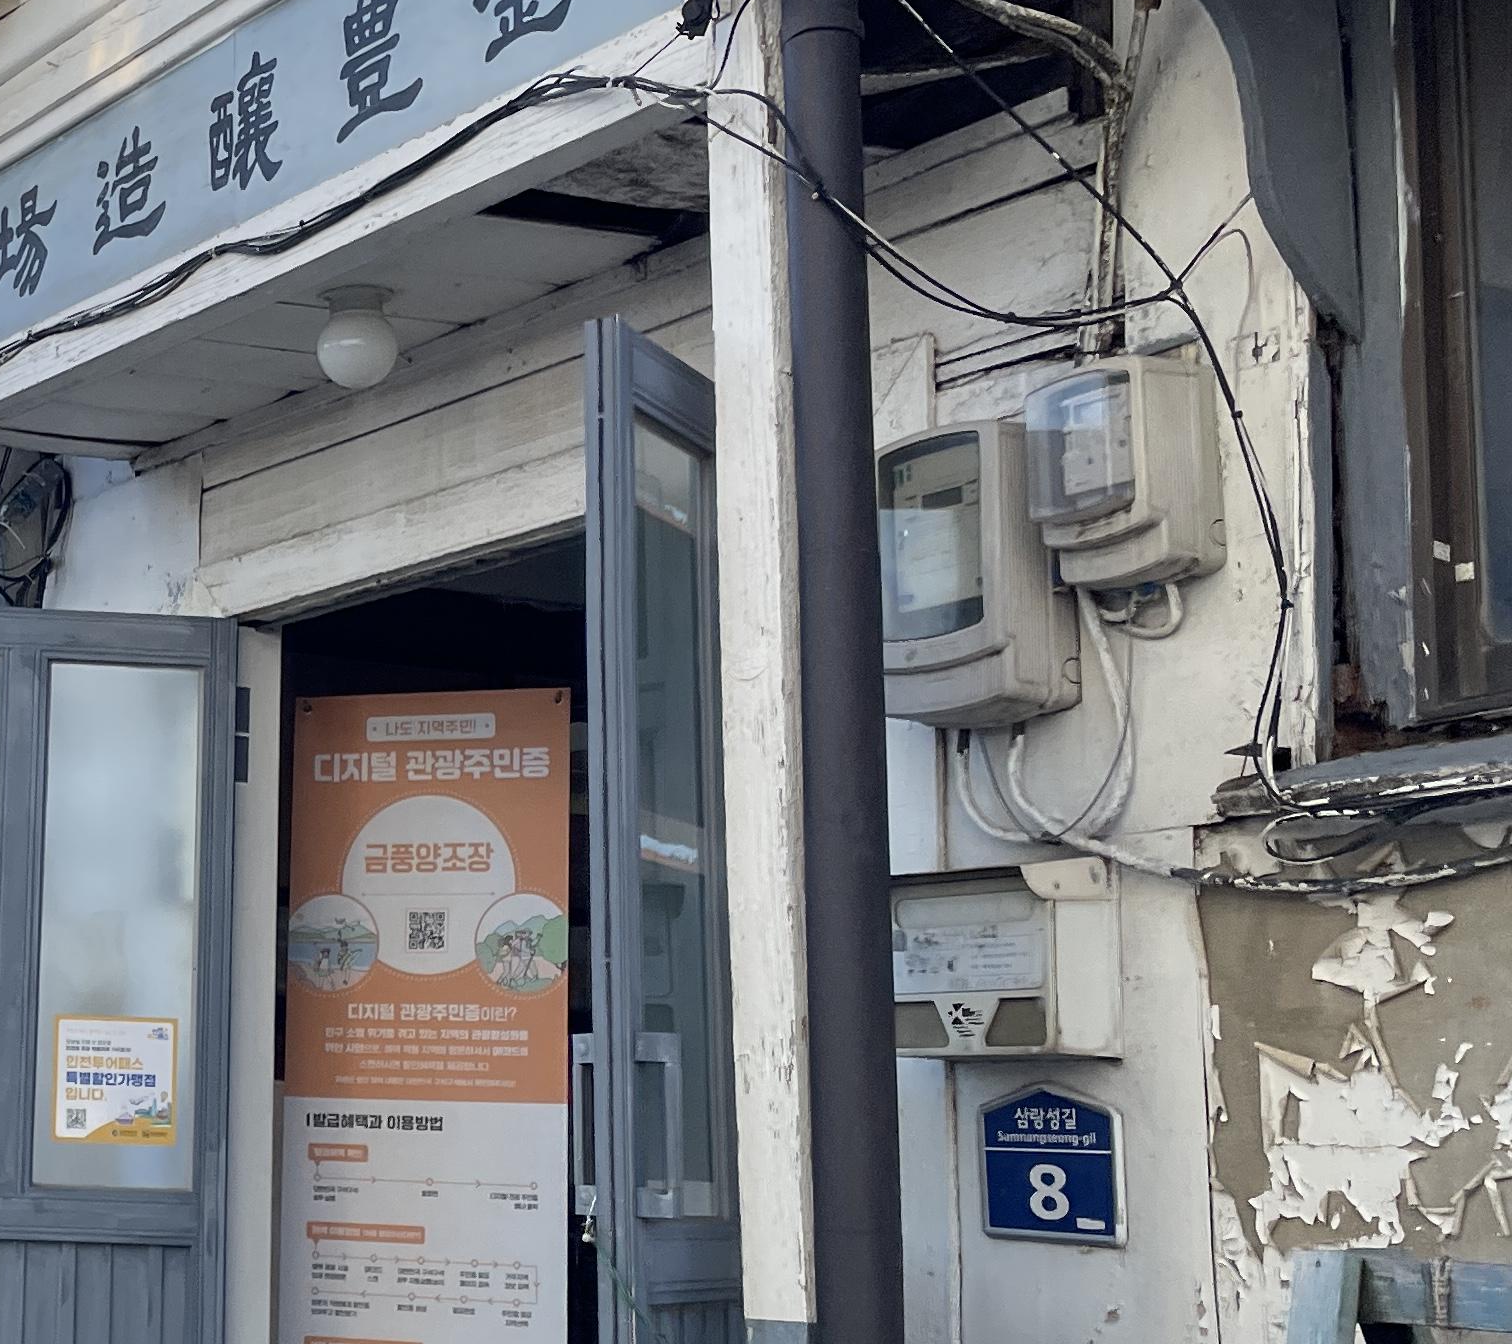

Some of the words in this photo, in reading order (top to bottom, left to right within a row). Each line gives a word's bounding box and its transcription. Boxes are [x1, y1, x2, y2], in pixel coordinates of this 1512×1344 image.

[313, 751, 397, 783] 디지털
[405, 746, 551, 782] 관광주민증
[364, 842, 494, 874] 금풍양조장
[347, 1003, 396, 1022] 디지털
[65, 1071, 157, 1088] 특별할인가맹점
[313, 1112, 383, 1129] 발급혜택과
[387, 1115, 444, 1132] 이용방법
[1014, 1107, 1077, 1130] 삼랑성길
[1029, 1163, 1070, 1221] 8
